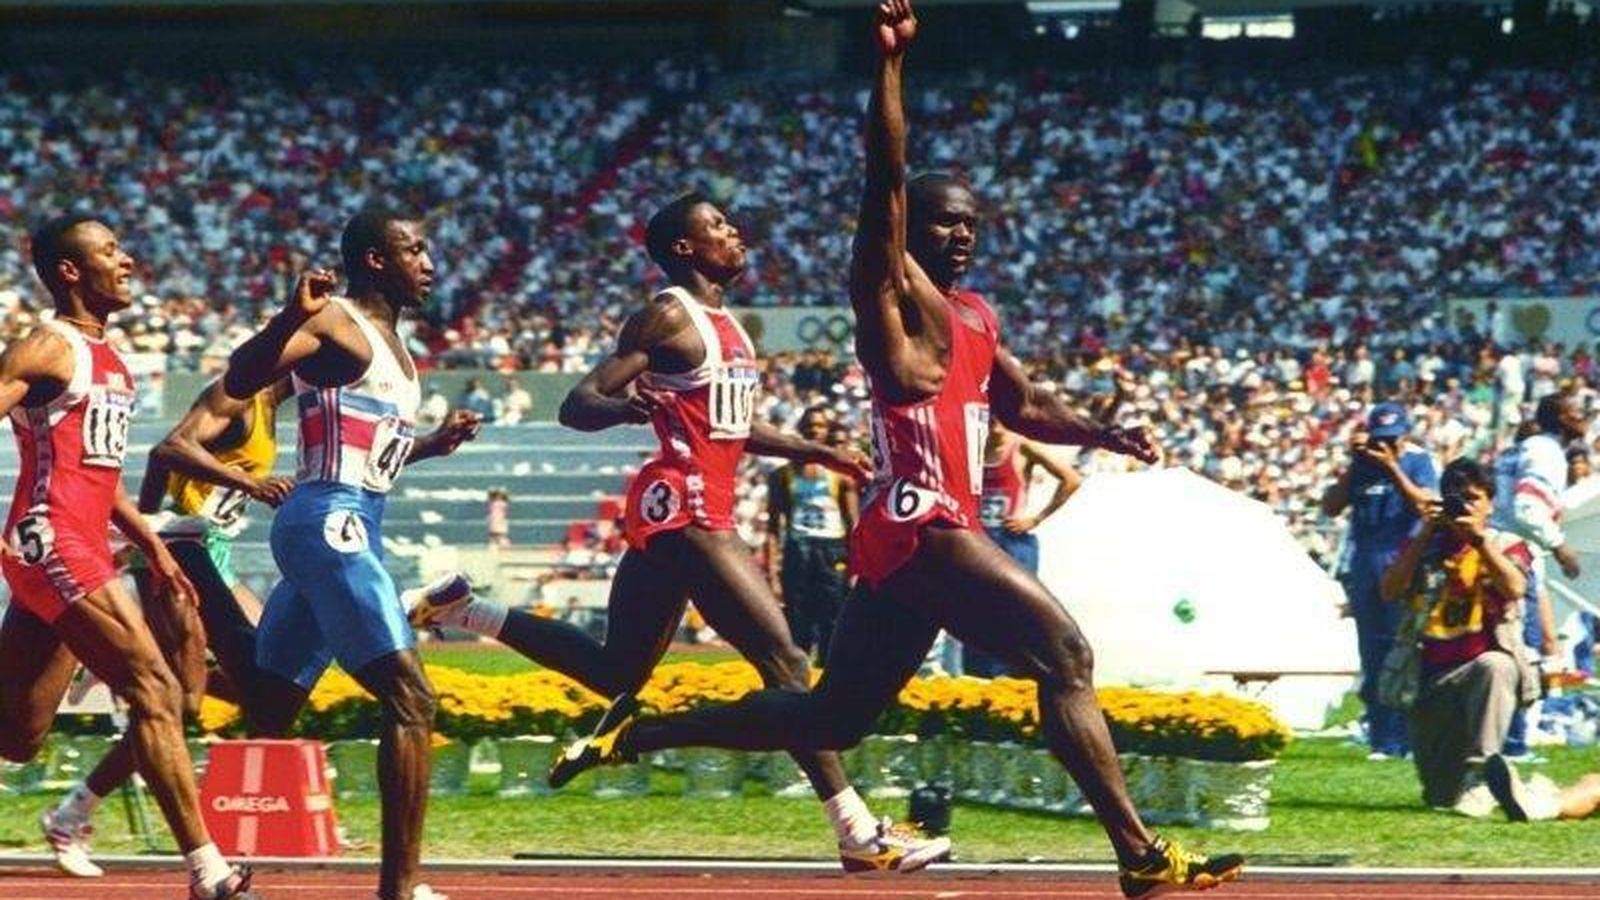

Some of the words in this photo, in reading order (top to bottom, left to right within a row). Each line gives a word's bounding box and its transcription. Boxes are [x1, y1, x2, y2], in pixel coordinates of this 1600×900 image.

[647, 481, 672, 522] 3
[894, 479, 919, 517] 6
[16, 517, 44, 564] 5
[211, 795, 291, 812] OMEGA
